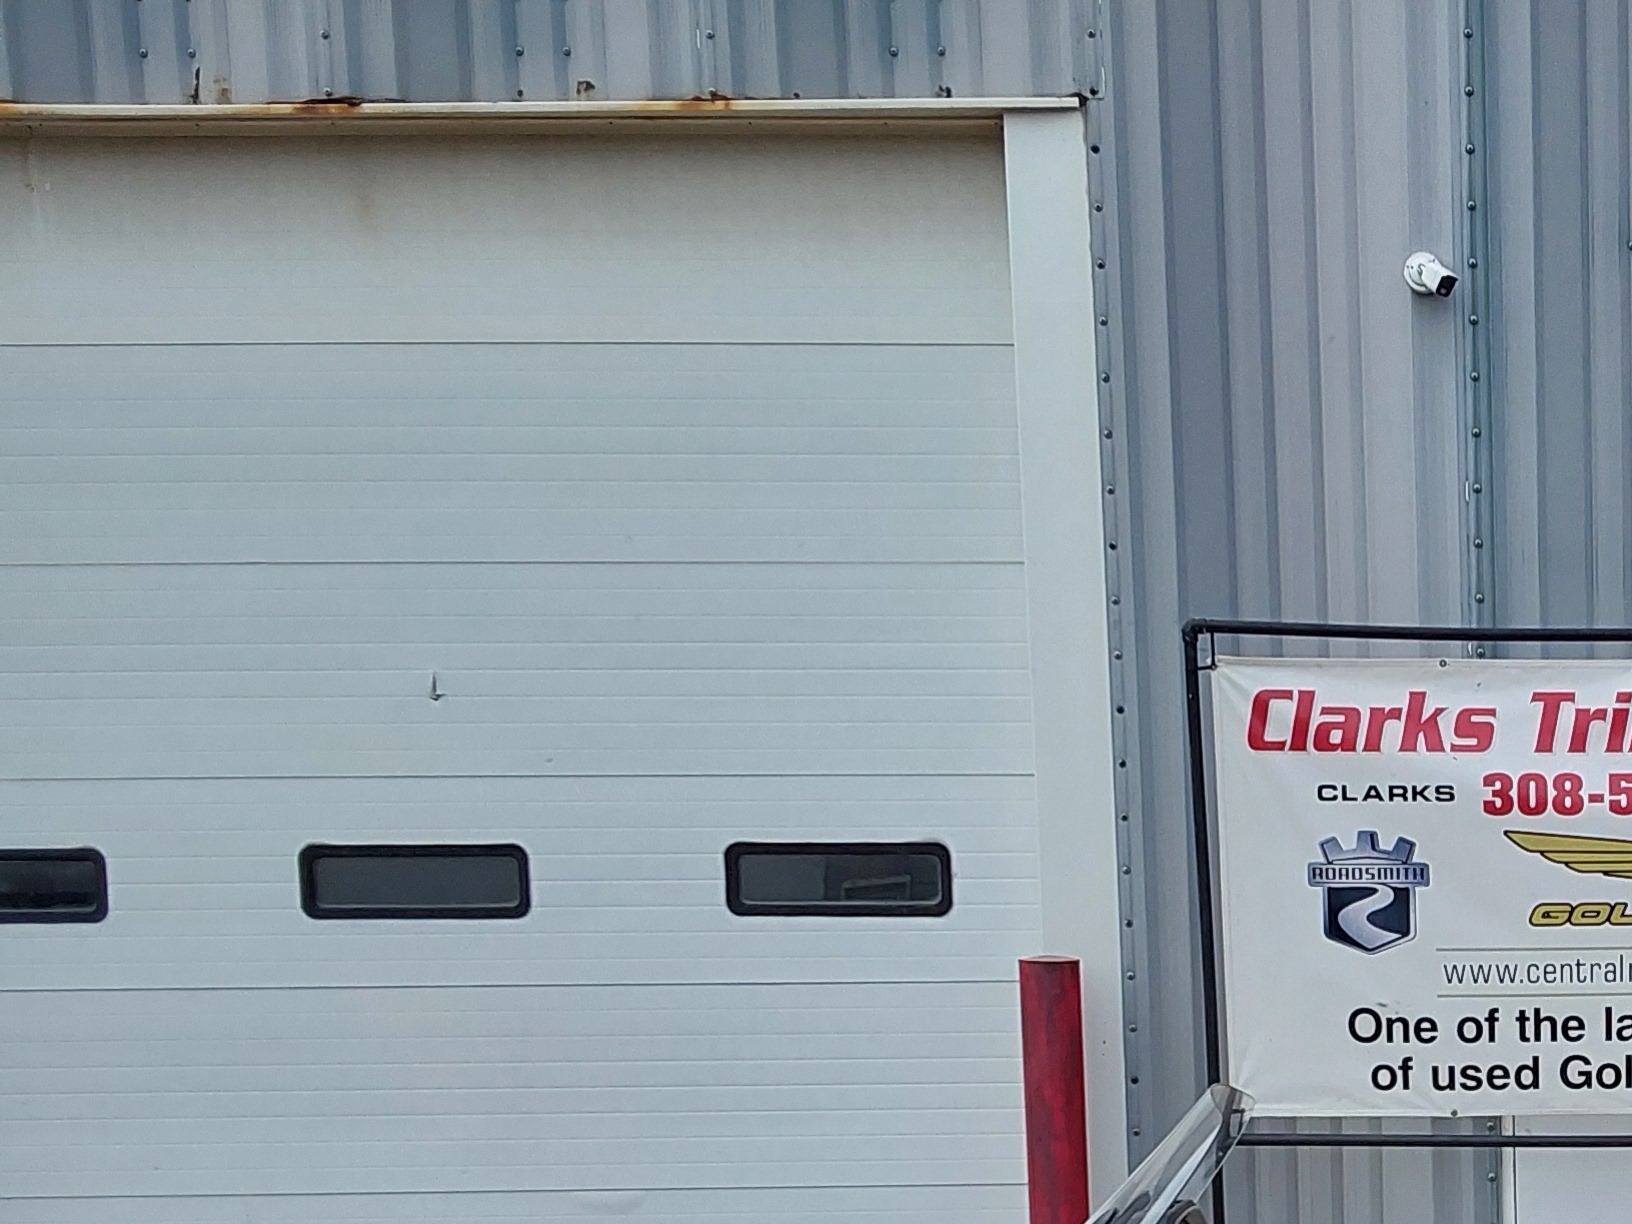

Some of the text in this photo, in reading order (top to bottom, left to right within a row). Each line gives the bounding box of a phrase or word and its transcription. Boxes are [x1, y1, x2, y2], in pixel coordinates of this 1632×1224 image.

[1246, 689, 1496, 753] Clarks
[1317, 784, 1456, 803] CLARKS
[1312, 867, 1425, 880] ROADSMITH
[1347, 1008, 1439, 1045] One
[1456, 1007, 1500, 1044] of
[1514, 1007, 1586, 1043] the
[1370, 1055, 1414, 1092] of
[1431, 1055, 1540, 1092] used
